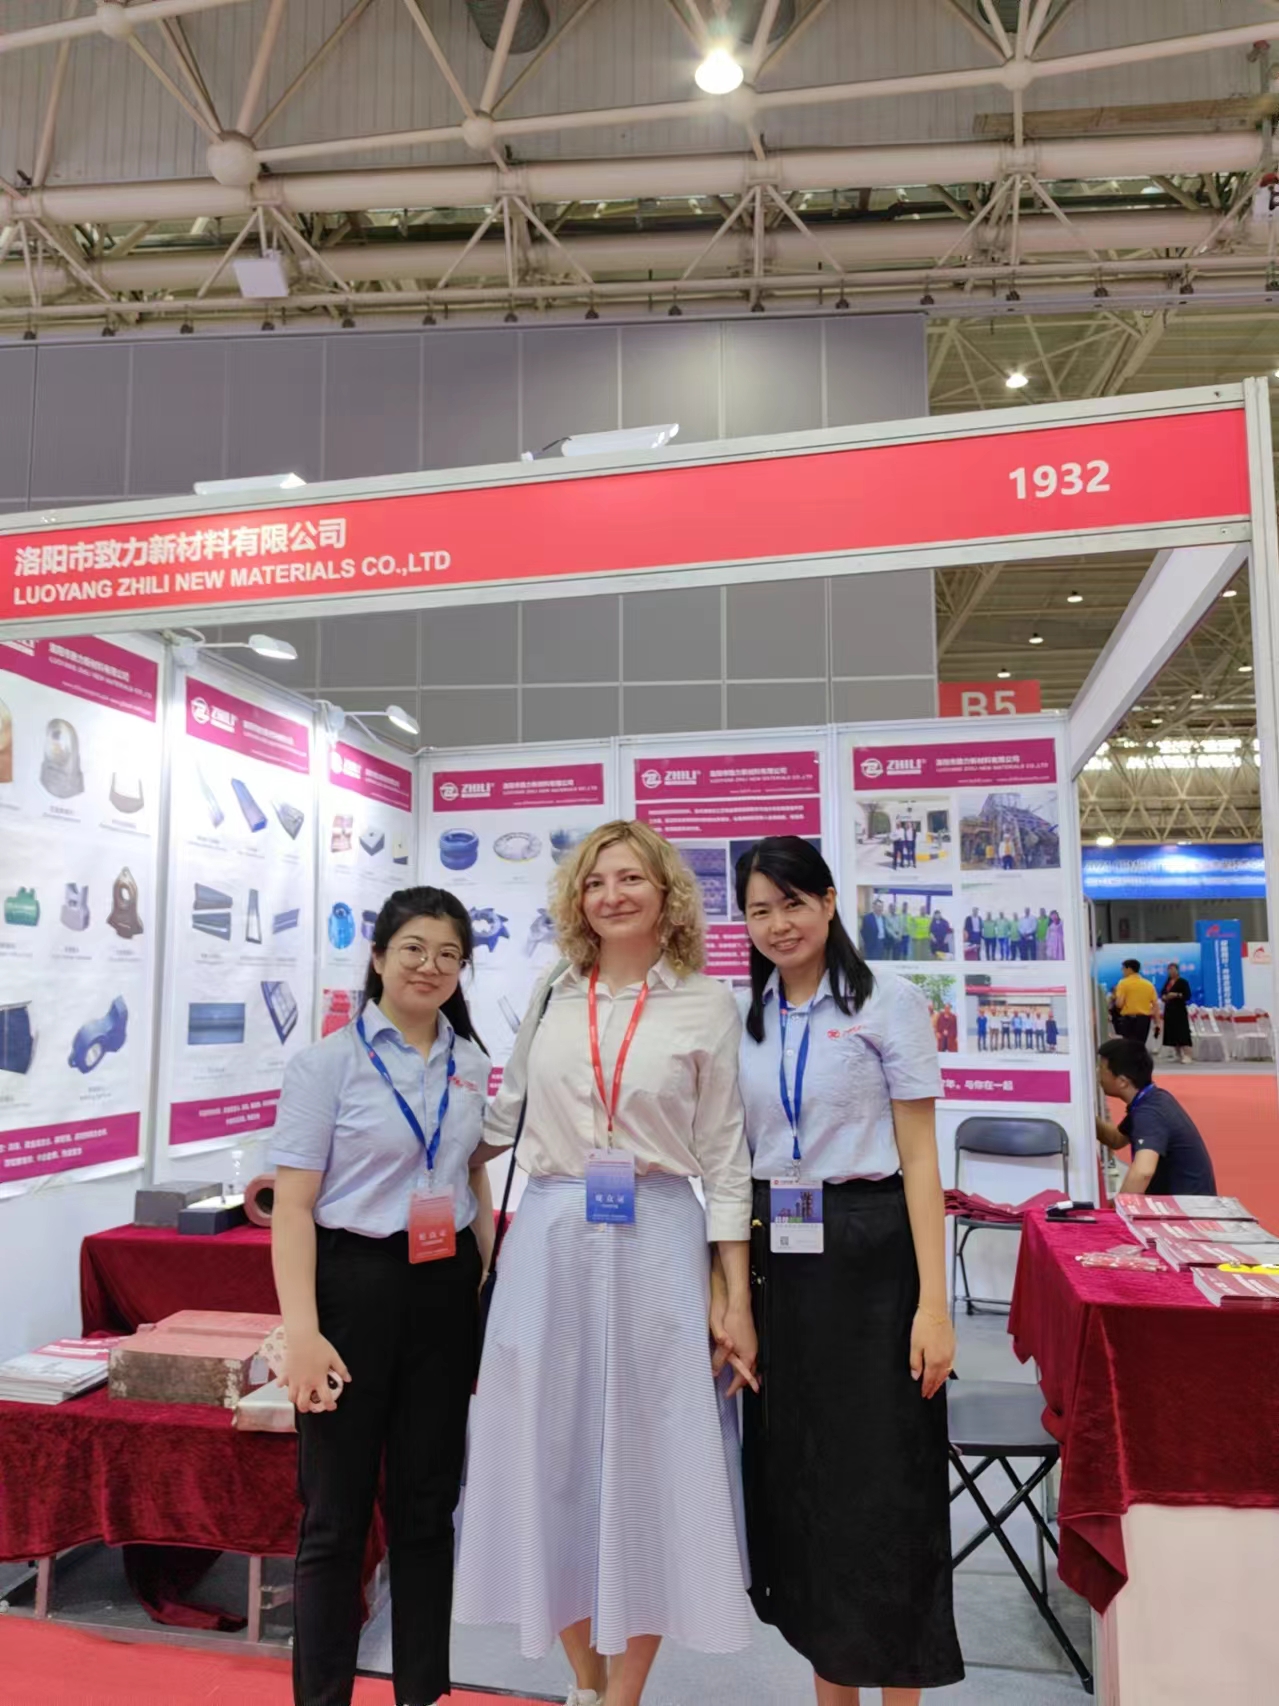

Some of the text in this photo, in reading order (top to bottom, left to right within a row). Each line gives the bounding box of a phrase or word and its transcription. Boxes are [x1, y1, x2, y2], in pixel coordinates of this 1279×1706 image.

[1009, 459, 1110, 499] 1932
[14, 518, 346, 576] 洛阳市致力新材料有限公司
[14, 550, 451, 605] LUOYANG ZHILI NEW MATERIALS CO.,LTD
[664, 770, 697, 781] ZHILI
[886, 759, 922, 771] ZHILI
